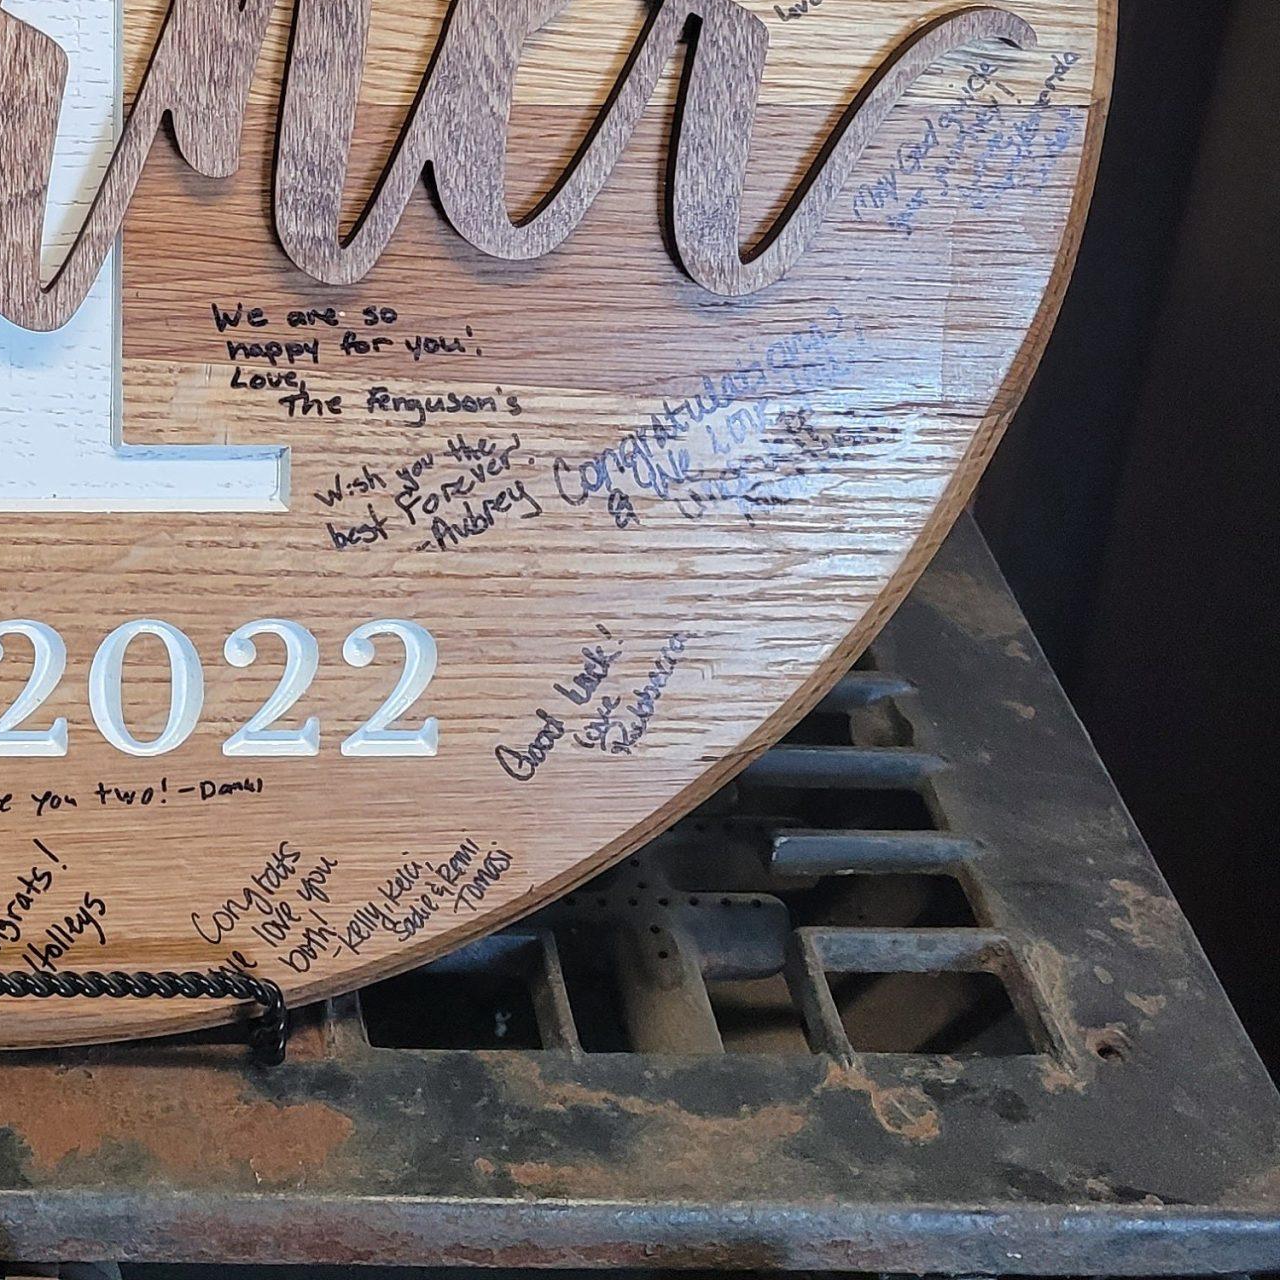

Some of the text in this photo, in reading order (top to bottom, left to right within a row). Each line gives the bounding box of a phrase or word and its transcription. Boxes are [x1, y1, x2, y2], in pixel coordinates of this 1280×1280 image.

[211, 302, 398, 332] We are so
[226, 337, 320, 366] happy
[339, 331, 393, 356] for
[314, 433, 496, 507] Wish you the
[325, 503, 389, 551] best
[495, 708, 564, 781] Good
[32, 791, 77, 817] you
[192, 840, 302, 945] Congrats
[251, 856, 338, 948] love you
